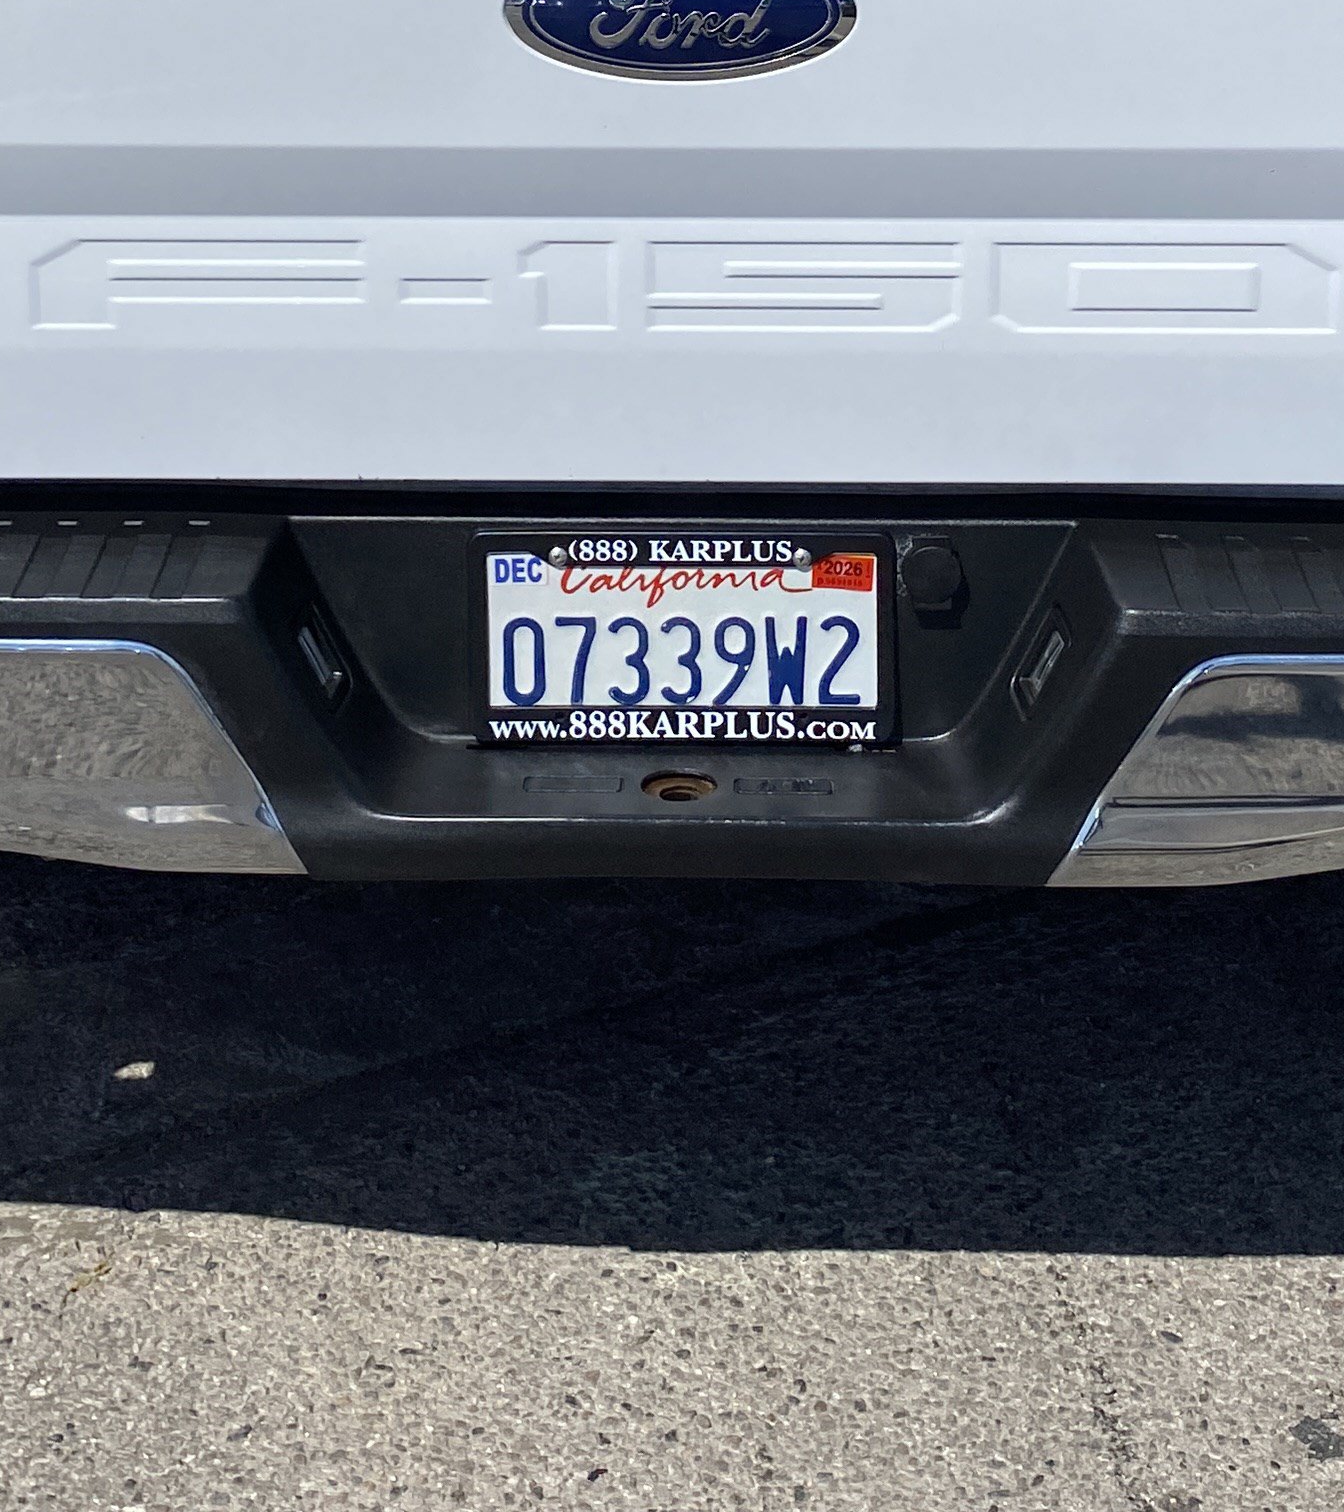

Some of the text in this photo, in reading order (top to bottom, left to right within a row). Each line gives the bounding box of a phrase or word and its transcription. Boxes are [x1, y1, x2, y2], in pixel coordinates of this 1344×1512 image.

[30, 238, 1340, 335] F-150
[567, 539, 793, 563] (888) KARPLUS
[823, 560, 864, 577] 2026
[494, 557, 544, 584] DEC
[560, 564, 814, 608] California
[502, 615, 862, 707] 07339W2
